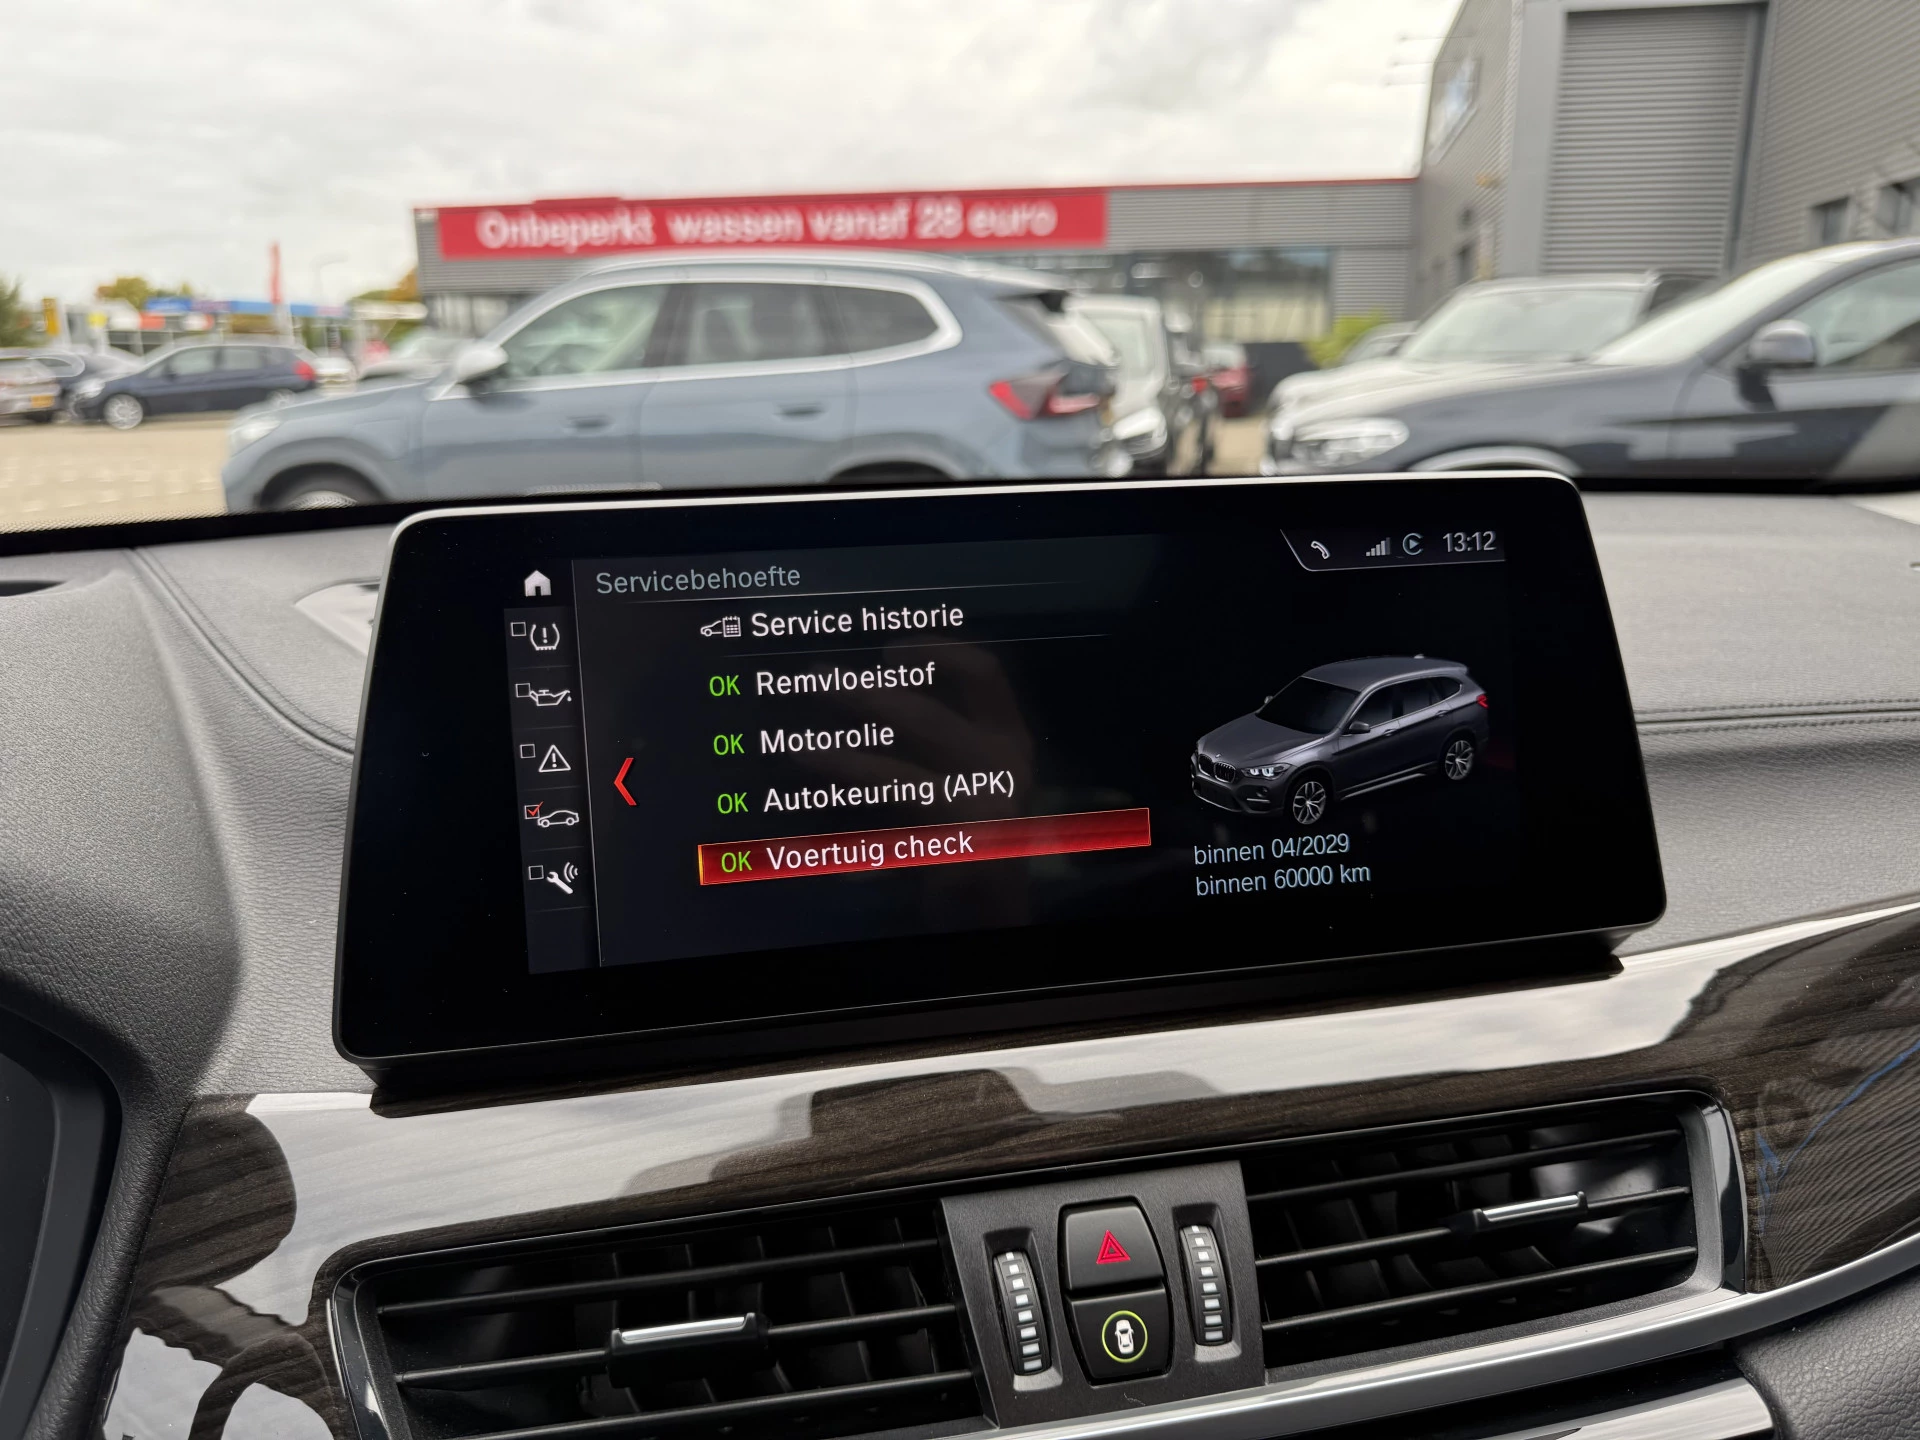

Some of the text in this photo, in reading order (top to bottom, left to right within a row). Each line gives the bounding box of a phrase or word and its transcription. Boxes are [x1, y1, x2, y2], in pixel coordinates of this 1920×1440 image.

[476, 208, 655, 253] Onbeperkt
[670, 207, 804, 244] wassen
[809, 200, 911, 241] vanaf
[967, 200, 1058, 238] euro
[1442, 530, 1495, 553] 13:12
[596, 566, 801, 595] Servicebehoefte
[751, 603, 964, 637] Service historie
[709, 661, 936, 697] OK Remvloeistof
[713, 722, 895, 756] OK Motorolie
[717, 770, 1014, 815] OK Autokeuring (APK)
[721, 830, 974, 873] OK Voertuig check
[1194, 833, 1349, 865] binnen 04/2029
[1195, 863, 1370, 896] binnen 60000 km
